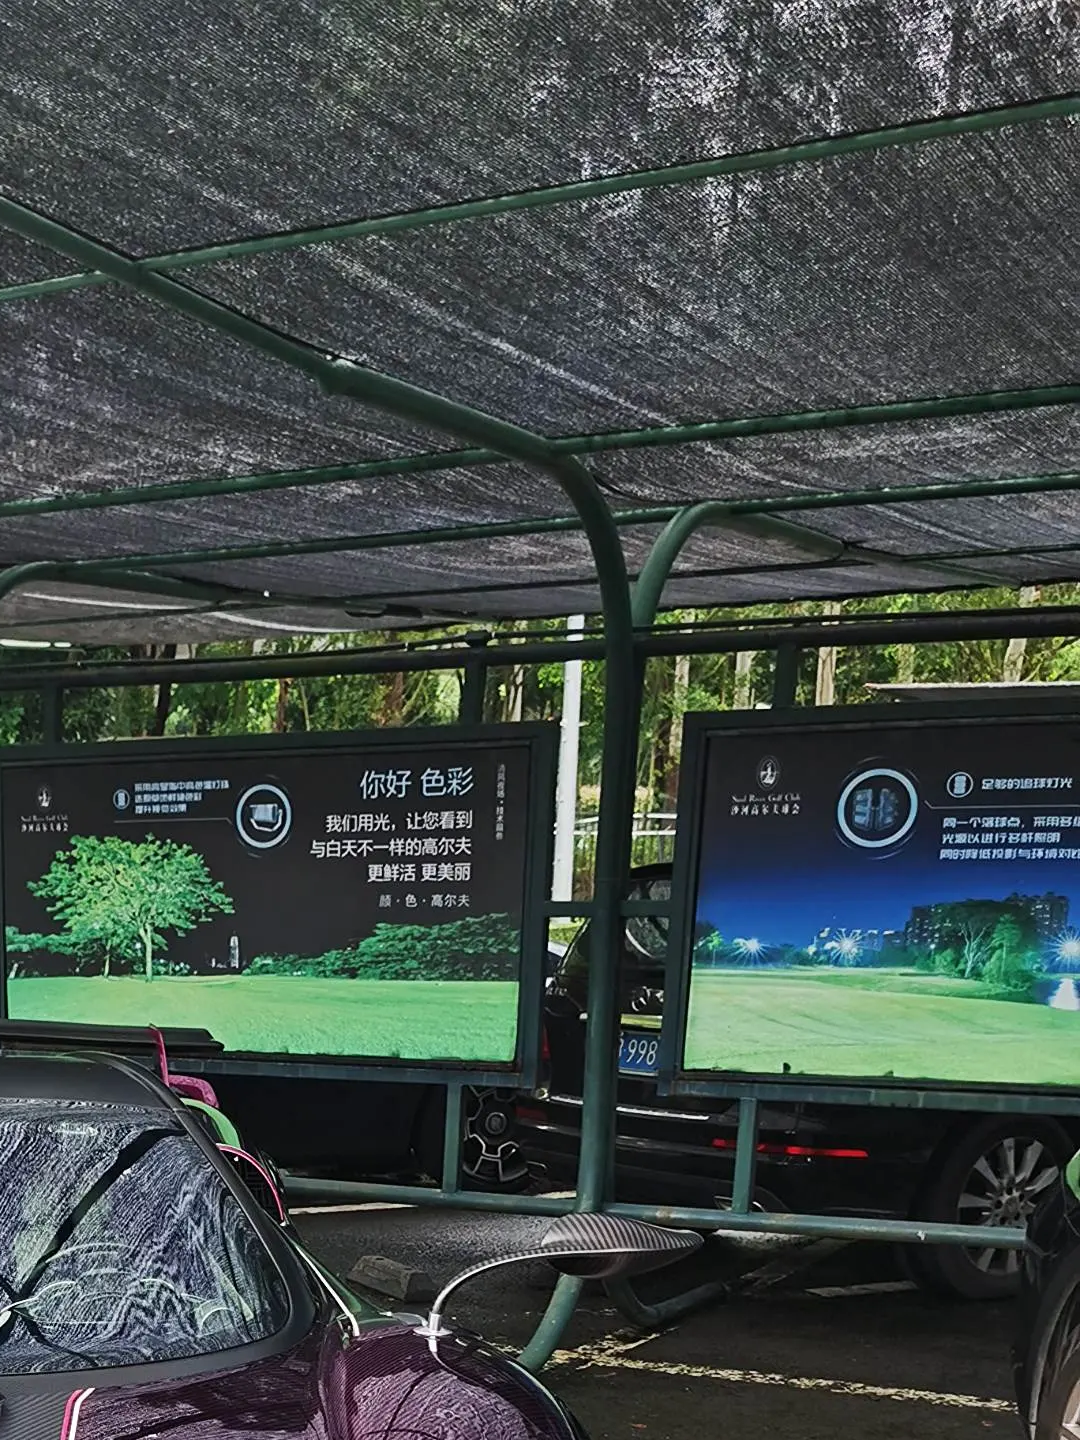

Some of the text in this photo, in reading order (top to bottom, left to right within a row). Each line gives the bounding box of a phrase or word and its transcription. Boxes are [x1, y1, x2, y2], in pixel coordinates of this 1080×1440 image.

[360, 766, 474, 799] 你好 色彩
[325, 810, 473, 833] 我们用光，让您看到
[309, 836, 472, 858] 与白天不一样的高尔夫
[368, 862, 471, 882] 更鲜活 更美丽
